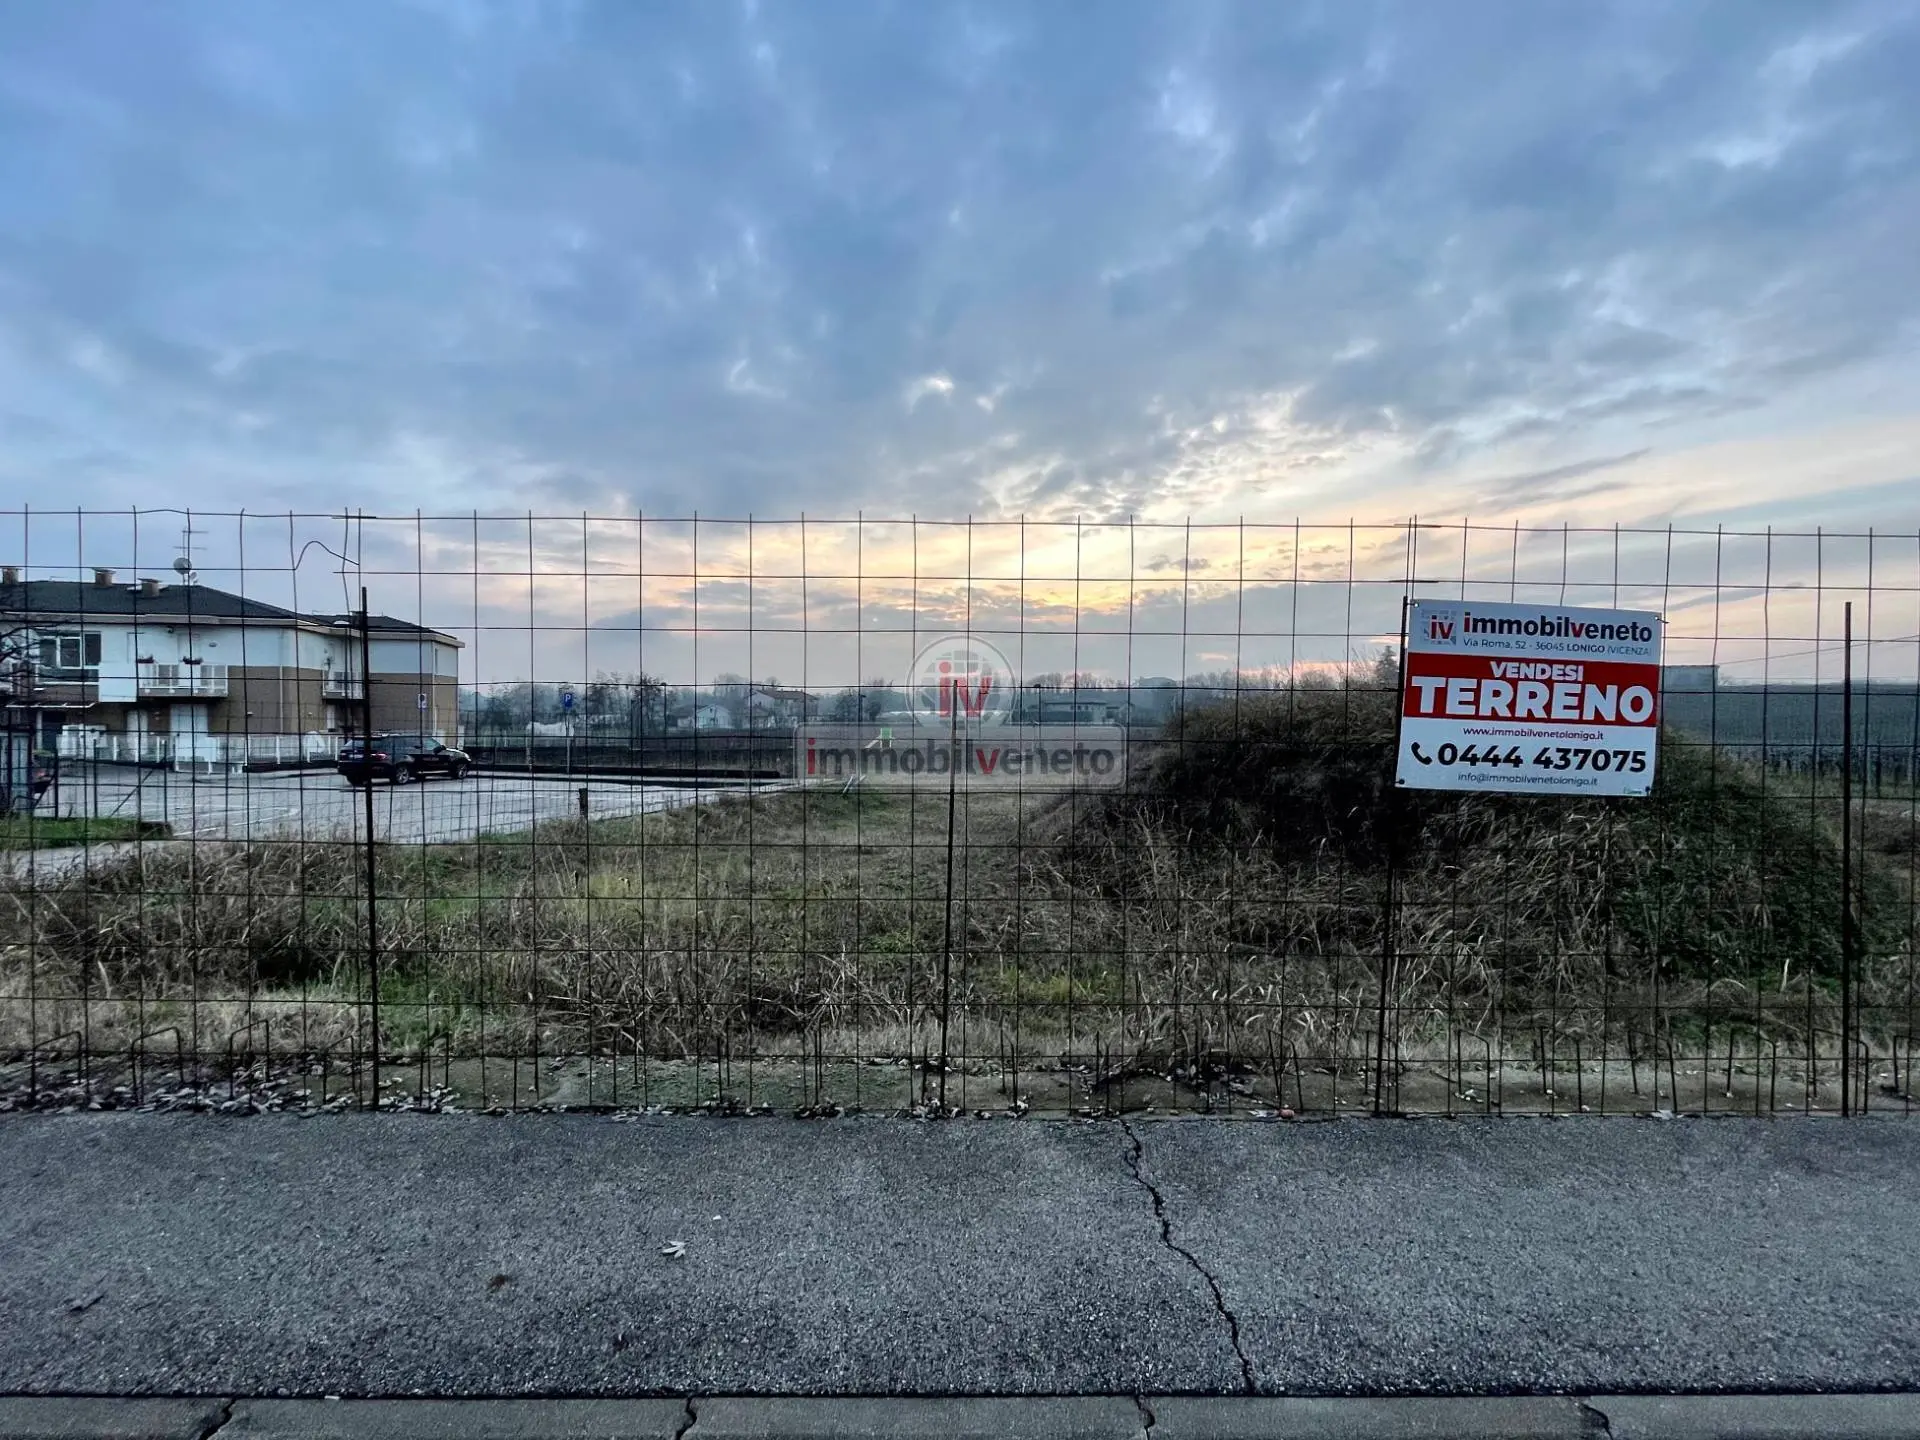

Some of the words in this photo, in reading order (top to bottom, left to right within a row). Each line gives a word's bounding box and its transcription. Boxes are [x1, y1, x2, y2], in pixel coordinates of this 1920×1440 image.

[1430, 614, 1454, 639] iv
[1463, 611, 1653, 642] immobilveneto
[1464, 639, 1478, 648] Via
[1515, 640, 1527, 650] 52
[1535, 641, 1564, 652] 36045
[1567, 643, 1605, 654] LONIGO
[1490, 661, 1584, 682] VENDESI
[1411, 676, 1654, 723] TERRENO
[1463, 727, 1604, 741] www.immobilvenetolonigo.it
[1438, 743, 1523, 769] 0444
[1533, 746, 1647, 773] 437075
[1458, 772, 1599, 787] info@immobilvenetolonigo.it
